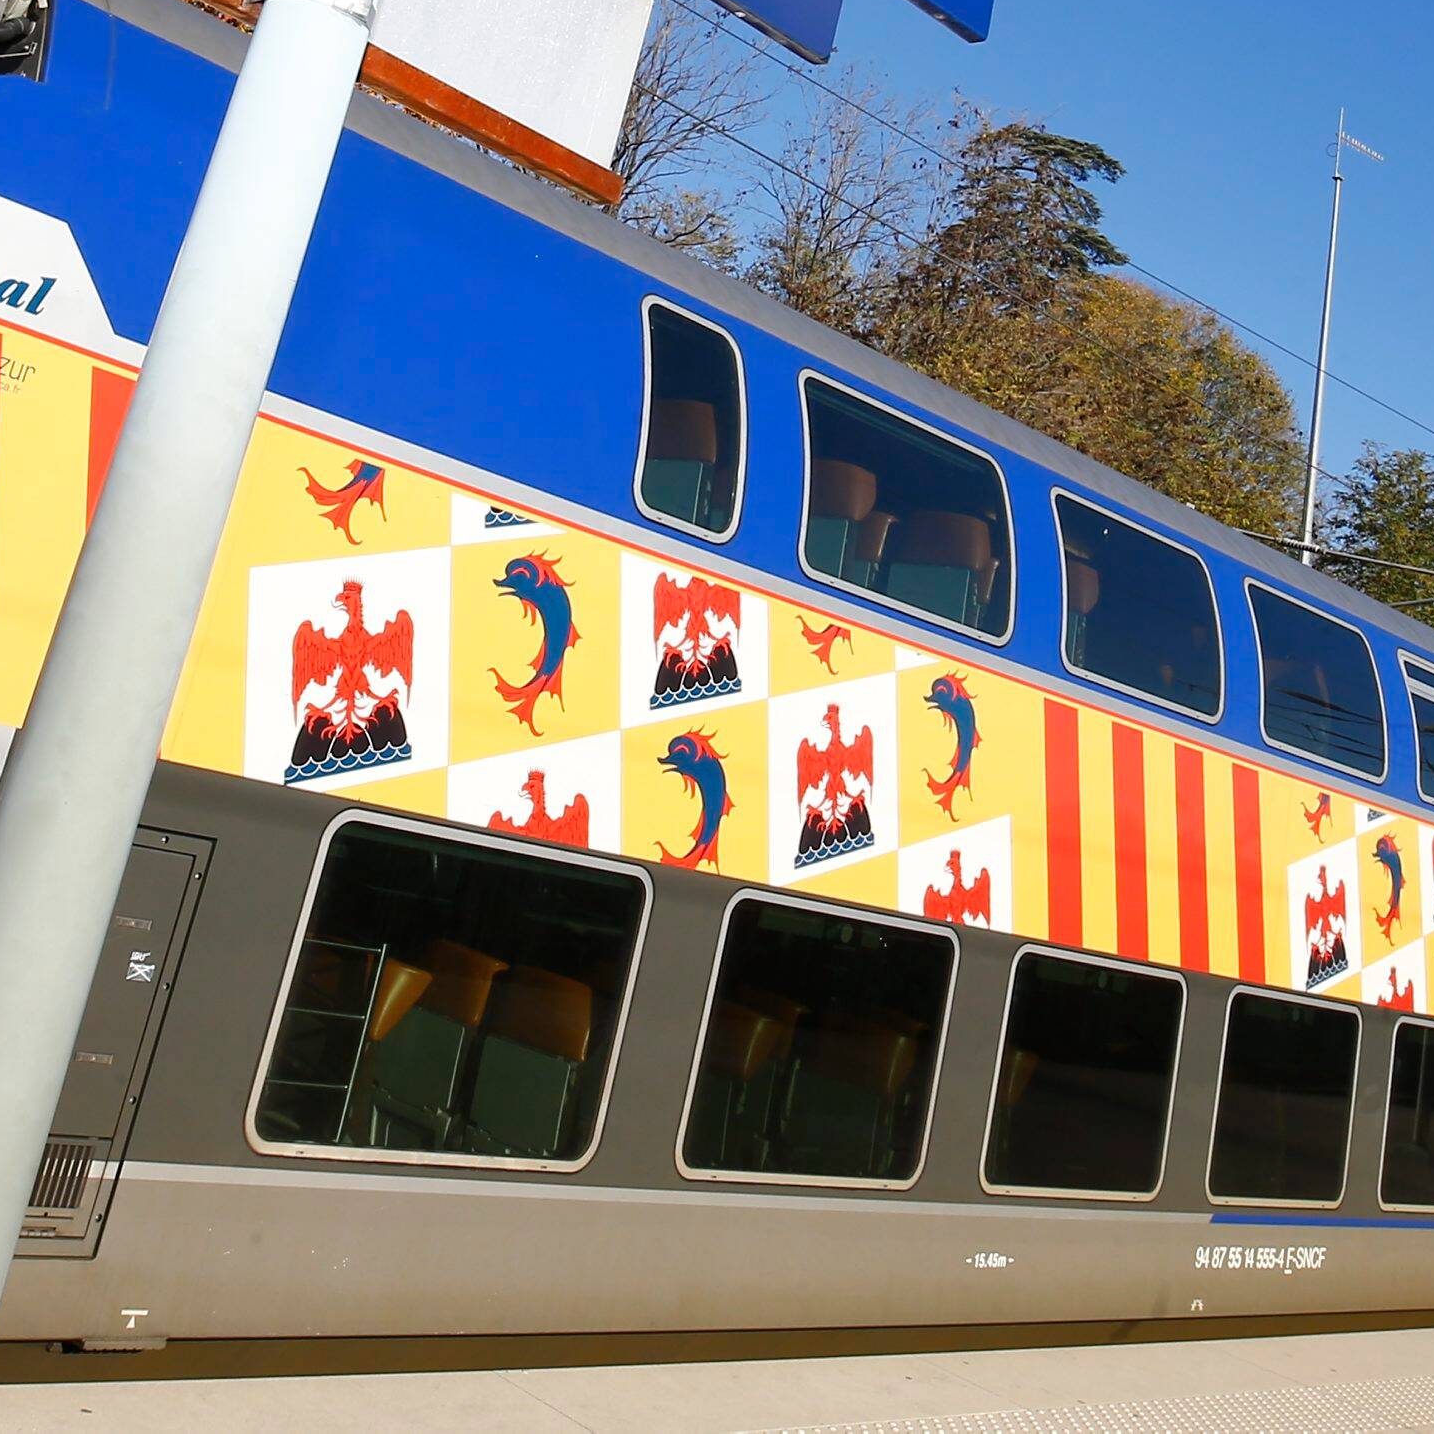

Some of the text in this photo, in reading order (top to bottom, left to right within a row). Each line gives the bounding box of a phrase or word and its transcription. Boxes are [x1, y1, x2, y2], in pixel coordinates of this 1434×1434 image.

[975, 1252, 1007, 1268] 15.45m
[1195, 1246, 1210, 1269] 94
[1211, 1246, 1227, 1269] 87
[1227, 1247, 1243, 1269] 55
